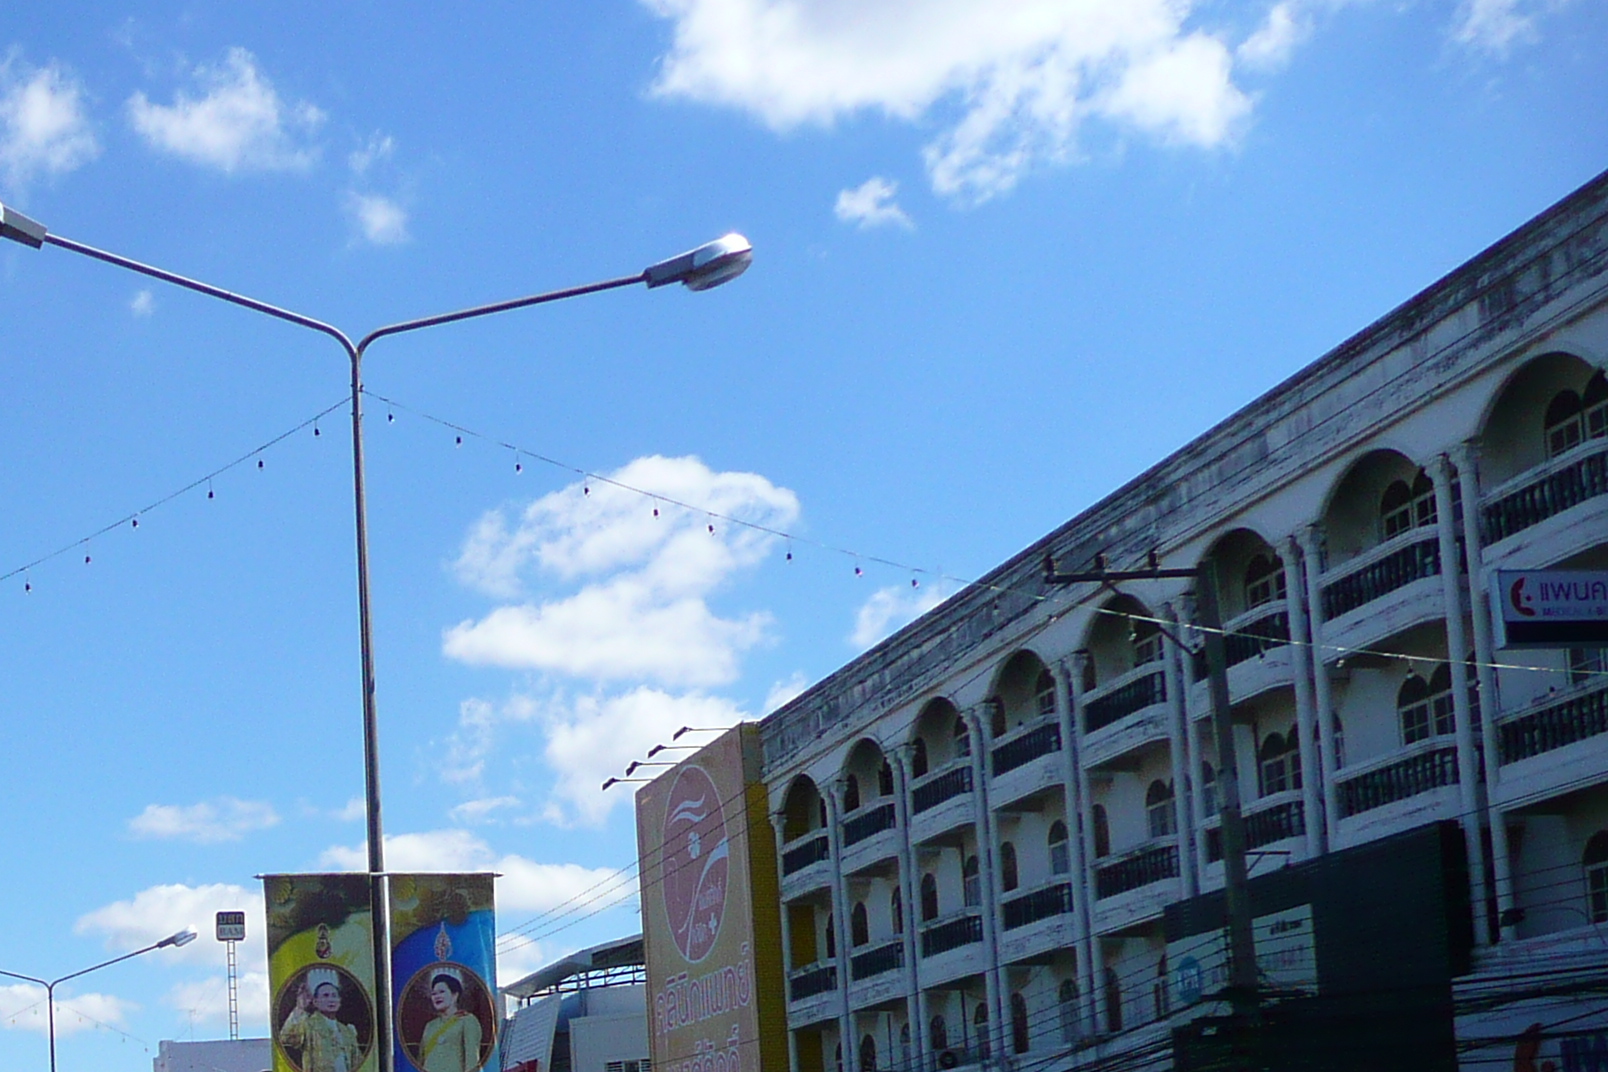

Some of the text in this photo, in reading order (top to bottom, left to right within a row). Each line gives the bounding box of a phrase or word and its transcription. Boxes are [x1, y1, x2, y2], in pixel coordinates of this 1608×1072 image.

[656, 941, 750, 1035] คลินิกแพทย์
